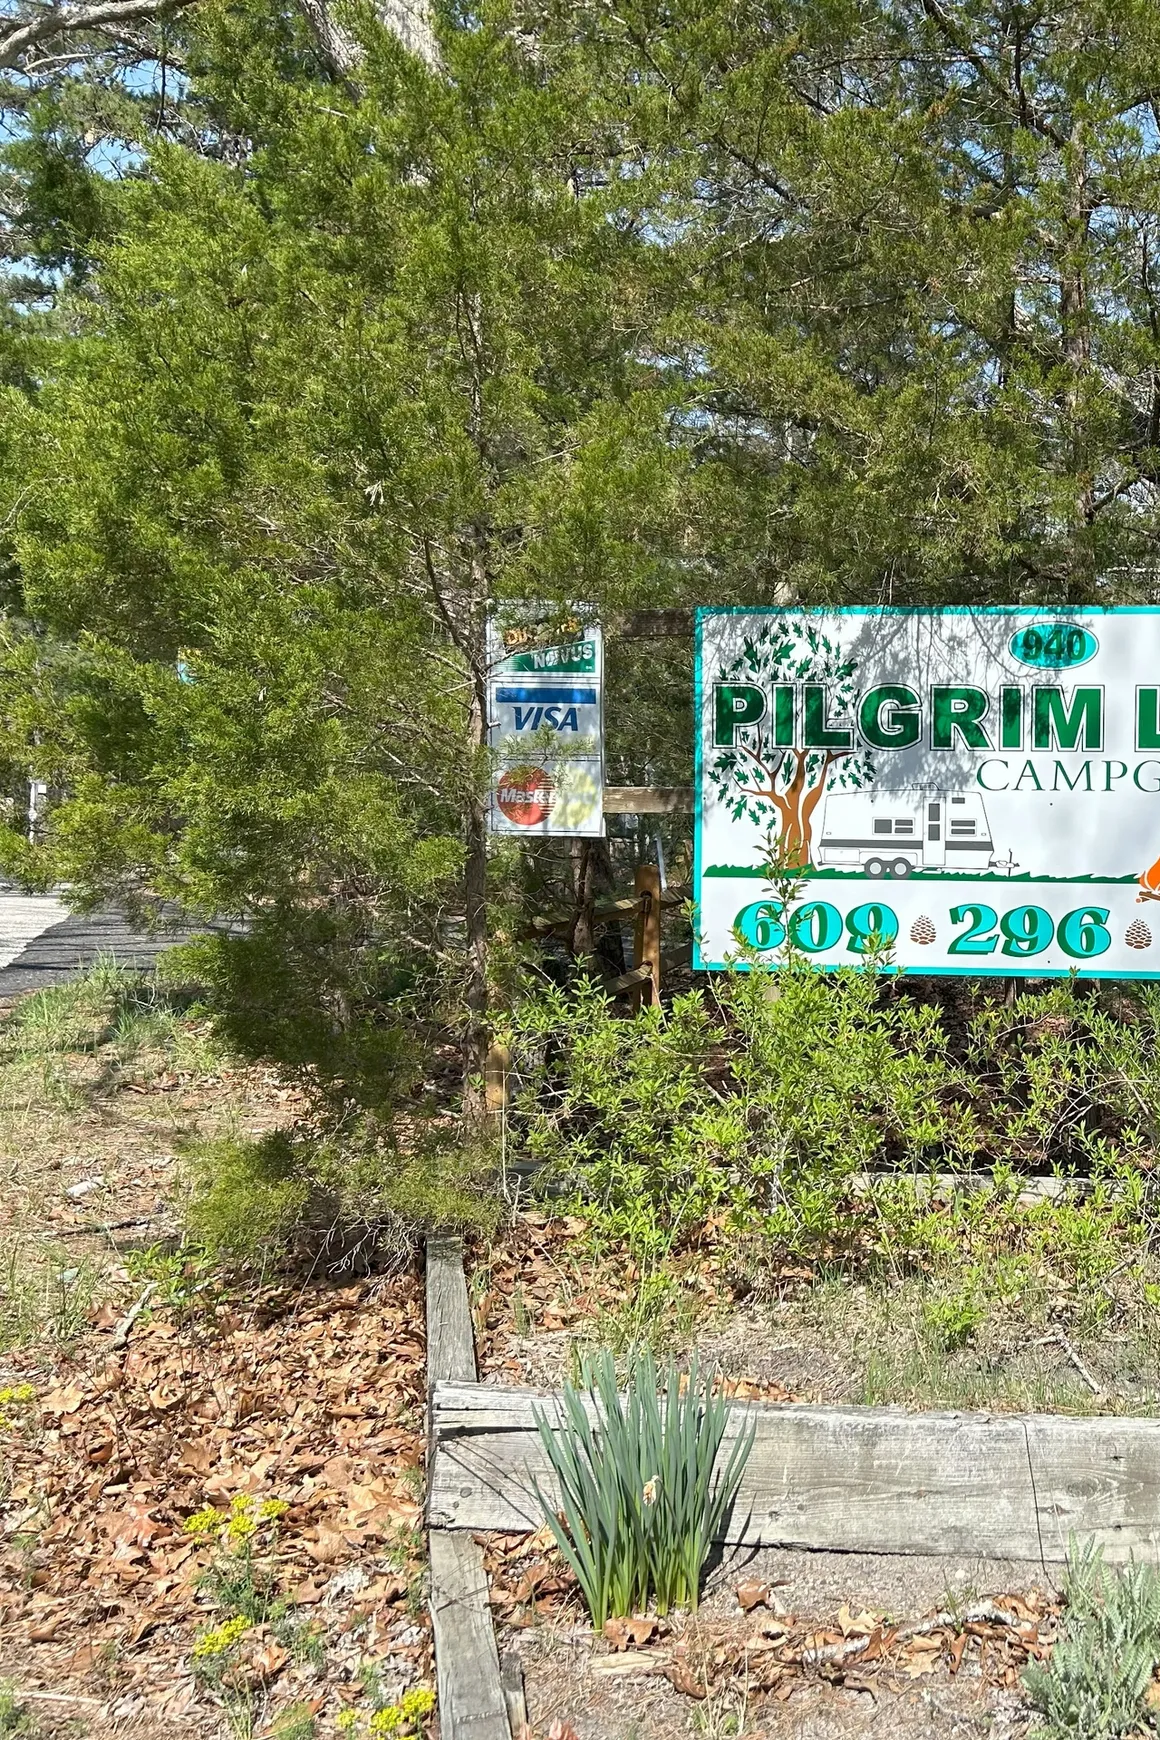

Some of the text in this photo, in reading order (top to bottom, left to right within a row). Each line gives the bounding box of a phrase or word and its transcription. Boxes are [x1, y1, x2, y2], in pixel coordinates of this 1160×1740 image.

[1021, 629, 1087, 660] 940
[512, 706, 579, 731] VISA
[712, 682, 1105, 752] PILGRIM
[734, 900, 899, 954] 609
[947, 903, 1112, 959] 296
